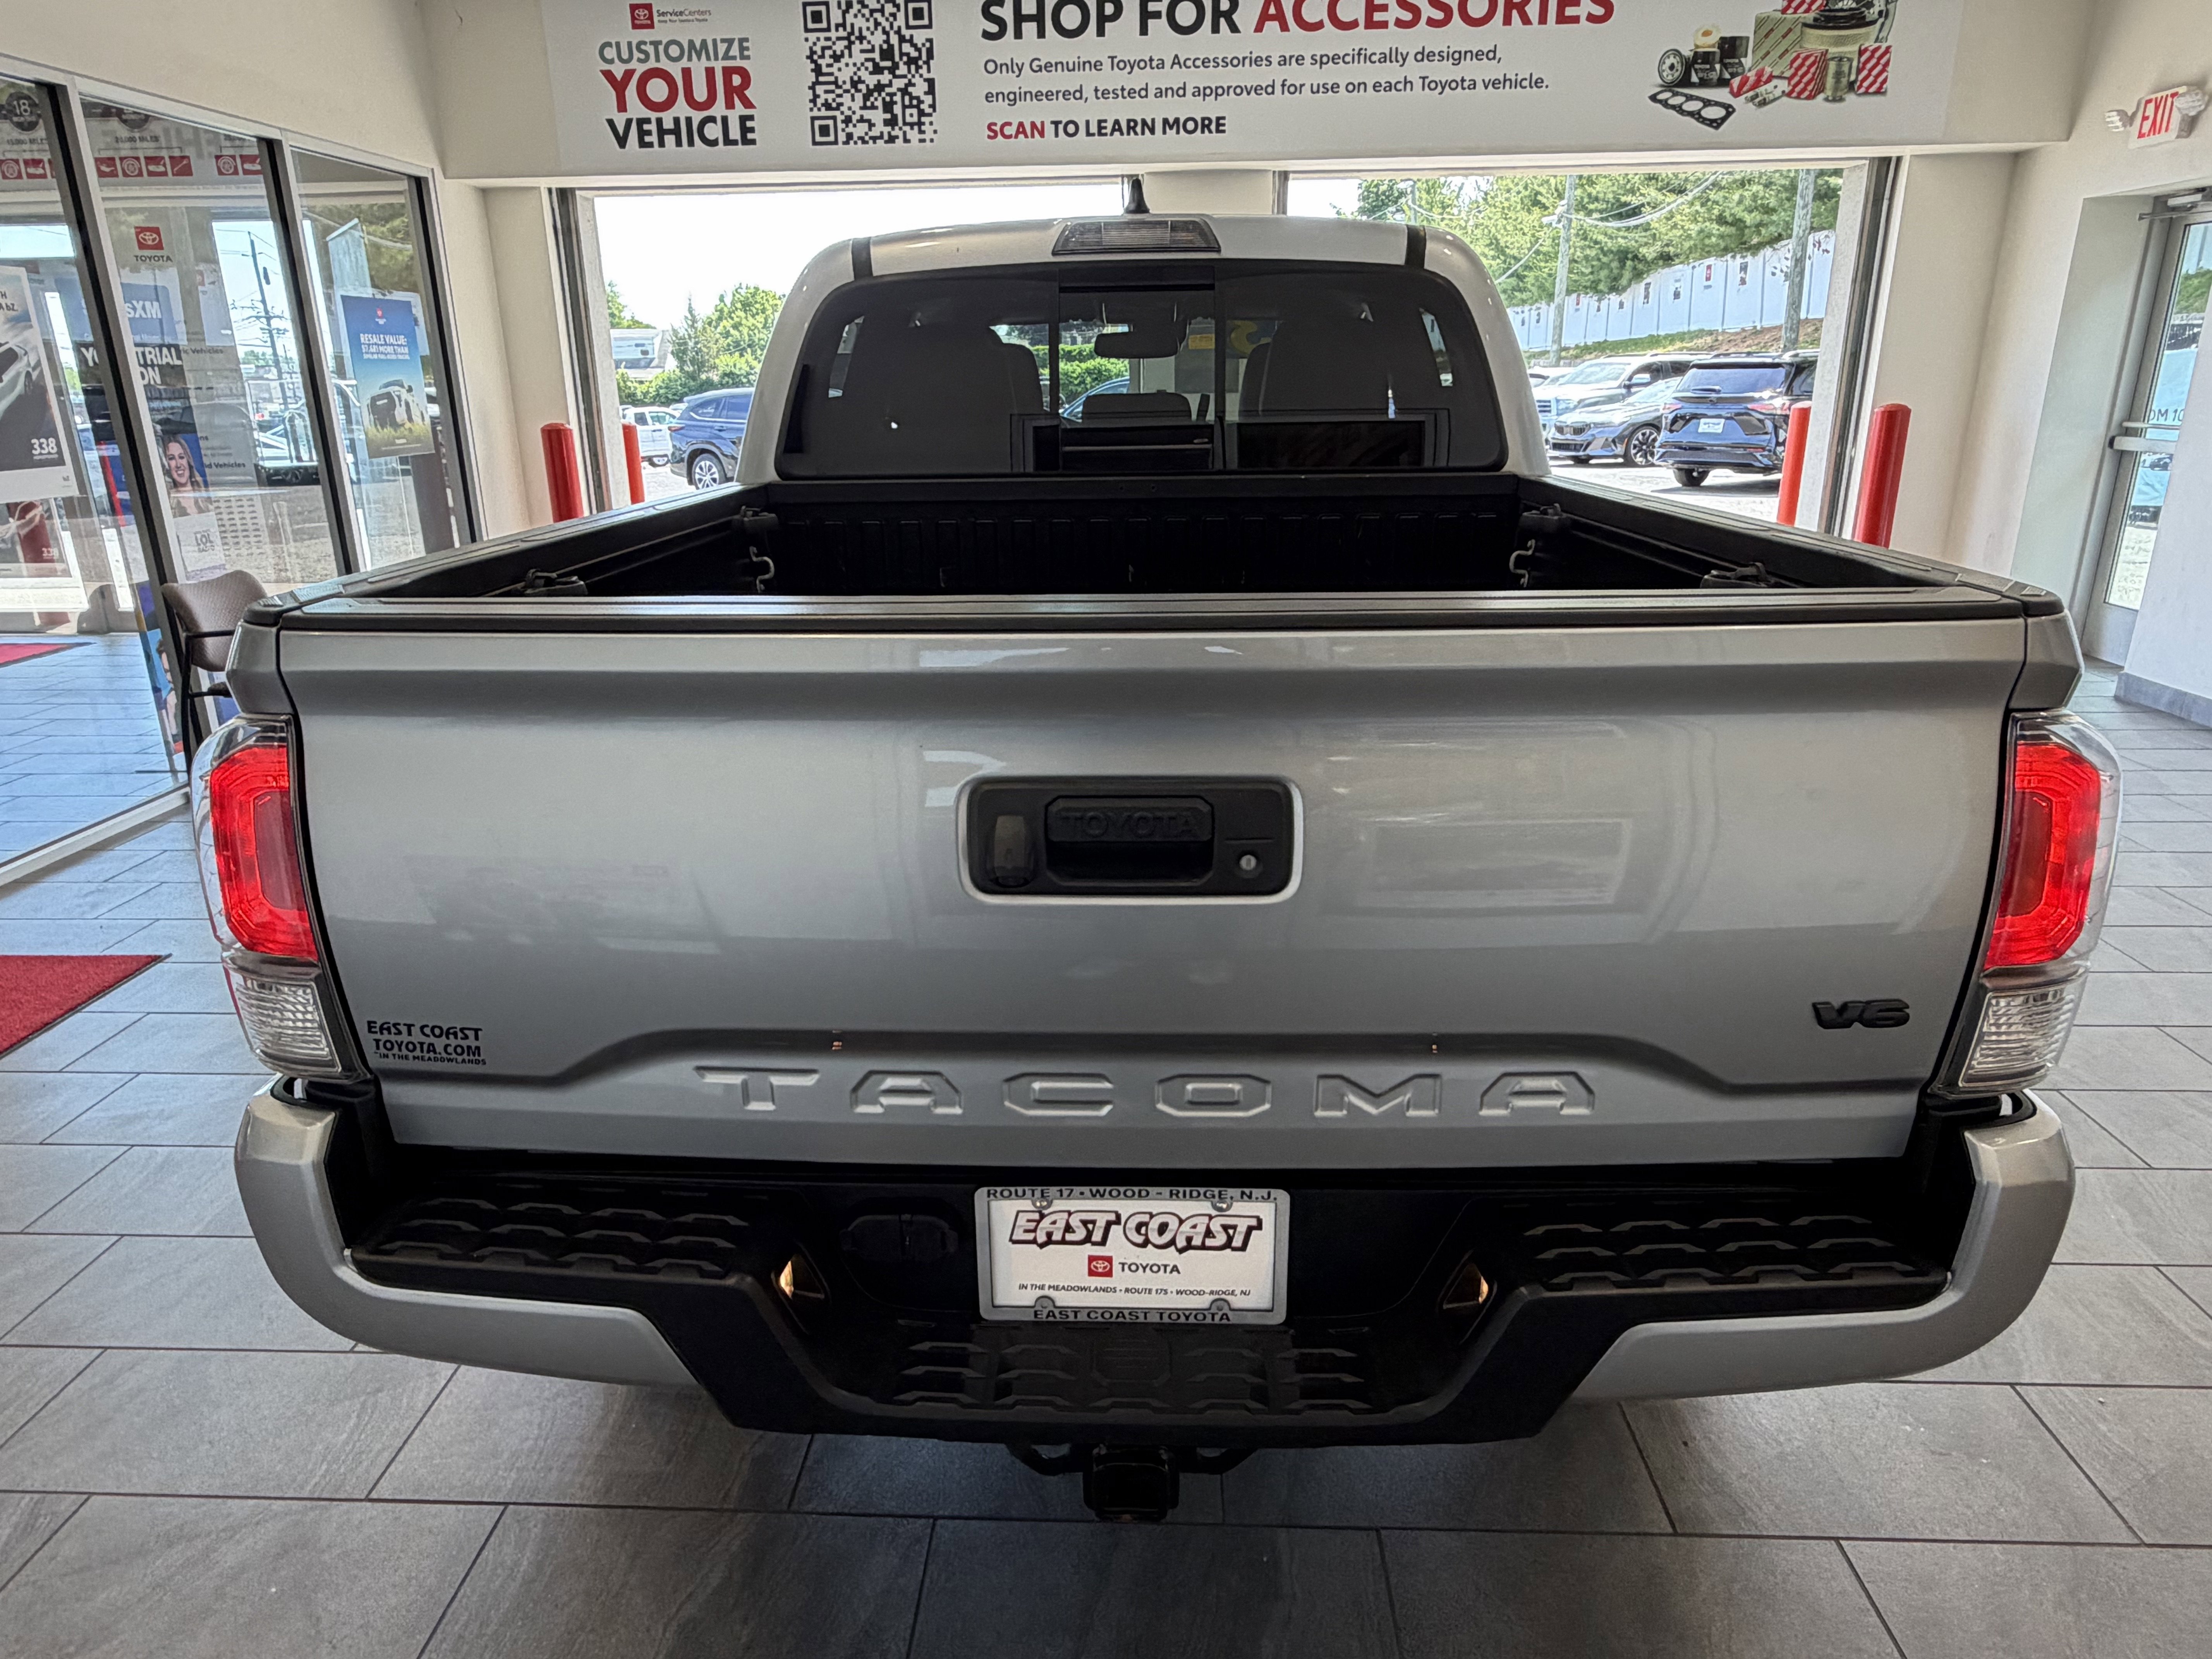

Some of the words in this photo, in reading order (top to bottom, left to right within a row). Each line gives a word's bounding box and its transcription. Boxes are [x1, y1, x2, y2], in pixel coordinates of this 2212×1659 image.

[981, 0, 1124, 41] SHOP
[1139, 0, 1241, 36] FOR
[1253, 0, 1614, 33] ACCESSORIES
[598, 36, 751, 65] CUSTOMIZE
[984, 57, 1024, 77] Only
[1030, 56, 1103, 74] Genuine
[1108, 54, 1165, 74] Toyota
[1170, 51, 1272, 70] Accessories
[1278, 52, 1305, 67] are
[1310, 47, 1409, 70] specifically
[1414, 45, 1502, 67] designed,
[599, 66, 757, 113] YOUR
[985, 84, 1088, 106] engineered,
[1094, 83, 1148, 101] tested
[1154, 82, 1186, 99] and
[1191, 80, 1275, 101] approved
[1280, 79, 1305, 94] for
[1310, 81, 1340, 94] use
[1345, 80, 1367, 93] on
[1372, 76, 1413, 93] each
[1419, 76, 1477, 95] Toyota
[1482, 73, 1549, 91] vehicle.
[14, 100, 30, 115] 18
[2137, 91, 2179, 139] EXIT
[605, 114, 757, 149] VEHICLE
[986, 121, 1045, 140] SCAN
[1050, 120, 1080, 138] TO
[1085, 118, 1156, 137] LEARN
[1162, 116, 1226, 136] MORE
[134, 254, 173, 263] TOYOTA
[360, 333, 385, 344] RESALE
[136, 347, 183, 365] TRIAL
[31, 438, 58, 455] 338
[1058, 811, 1202, 838] TOYOTA
[1812, 998, 1910, 1029] V6
[367, 1020, 415, 1036] EAST
[420, 1024, 483, 1041] COAST
[373, 1038, 481, 1058] TOYOTA.COM
[412, 1054, 487, 1066] MEADOWLANDS
[693, 1065, 1595, 1116] TACOMA
[987, 1188, 1050, 1199] ROUTE
[1056, 1188, 1074, 1198] 17
[1089, 1188, 1149, 1199] WOOD
[1169, 1189, 1234, 1201] RIDGE,
[1240, 1190, 1277, 1201] N.J.
[1009, 1210, 1121, 1249] EAST
[1123, 1211, 1263, 1255] COAST
[1118, 1262, 1181, 1274] TOYOTA
[1048, 1284, 1117, 1294] MEADOWLANDS
[1034, 1310, 1081, 1320] EAST
[1087, 1310, 1151, 1321] COAST
[1156, 1311, 1231, 1322] TOYOTA
